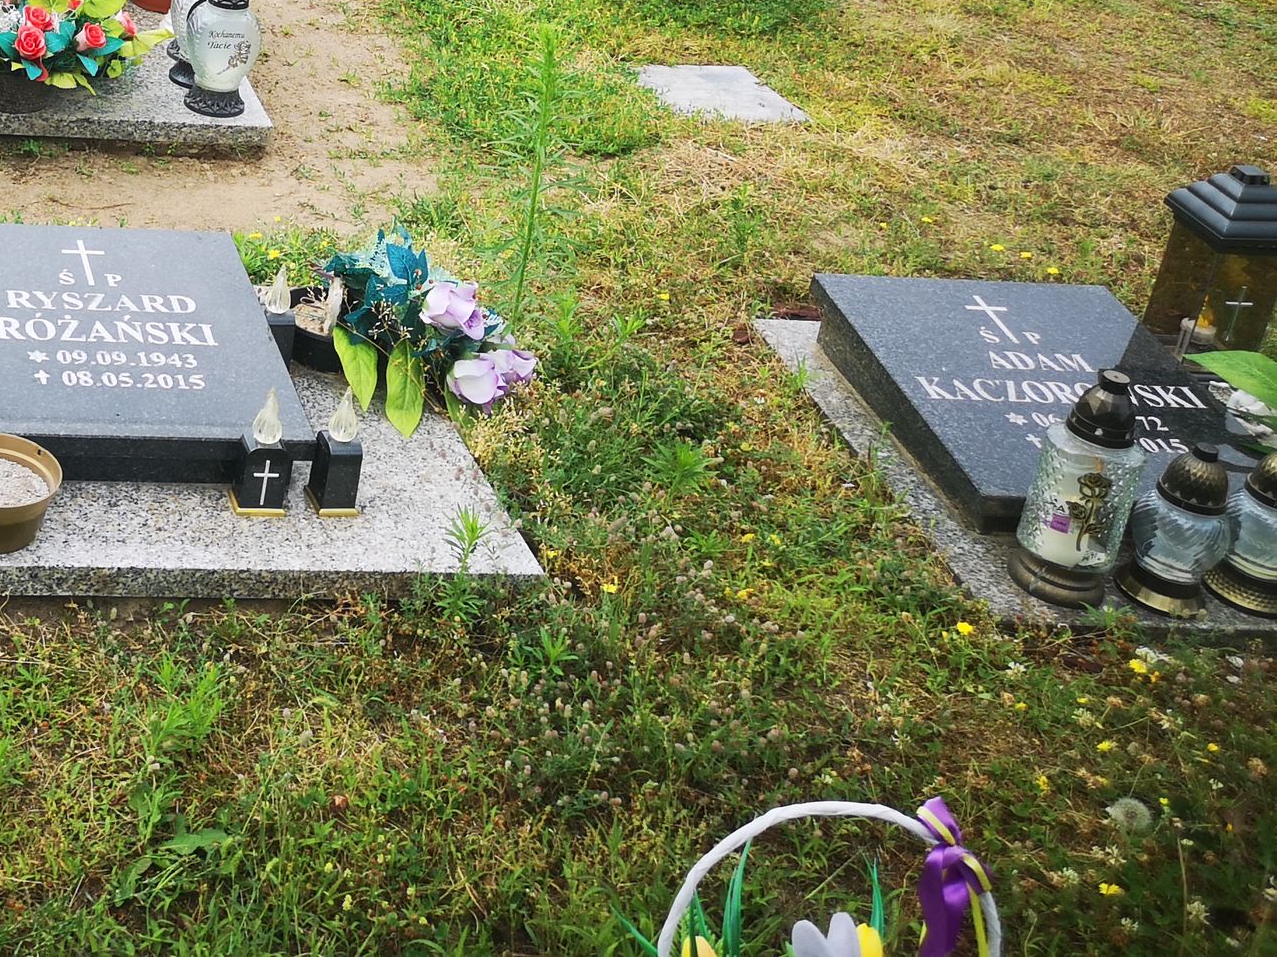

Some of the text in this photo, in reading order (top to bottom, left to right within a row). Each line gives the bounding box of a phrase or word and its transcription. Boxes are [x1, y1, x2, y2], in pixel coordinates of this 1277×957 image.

[207, 41, 232, 51] Tacie
[58, 268, 123, 288] Ś P
[4, 289, 198, 315] RYSZARD
[979, 326, 1042, 345] Ś P
[55, 349, 199, 369] 09.09.1943
[988, 350, 1100, 373] ADAM
[61, 370, 207, 390] 08.05.2015
[914, 375, 1210, 410] KACZOROSKI
